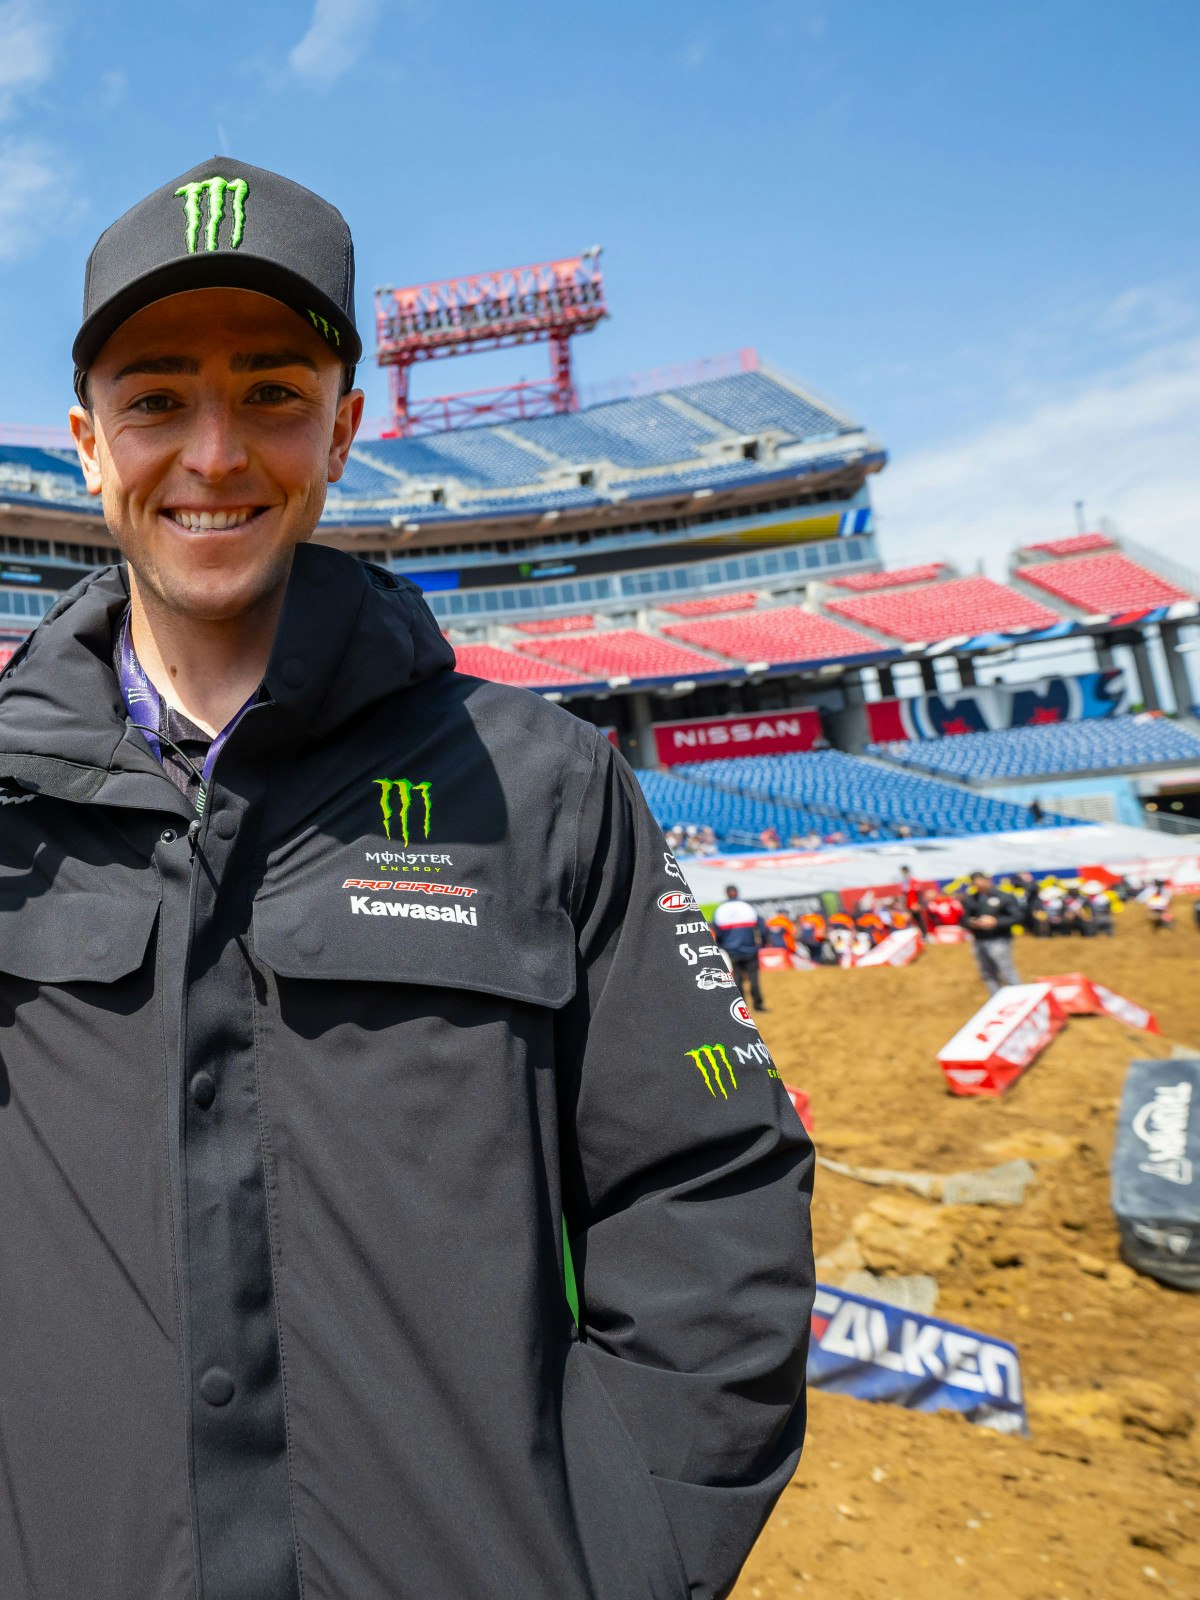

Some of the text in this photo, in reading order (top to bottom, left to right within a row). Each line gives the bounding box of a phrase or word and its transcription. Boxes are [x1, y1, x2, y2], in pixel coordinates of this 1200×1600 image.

[673, 719, 801, 748] NISSAN
[365, 850, 453, 866] MONSTER
[380, 865, 441, 873] ENERGY
[342, 878, 478, 898] PRO CIRCUIT
[350, 895, 478, 927] Kawasaki
